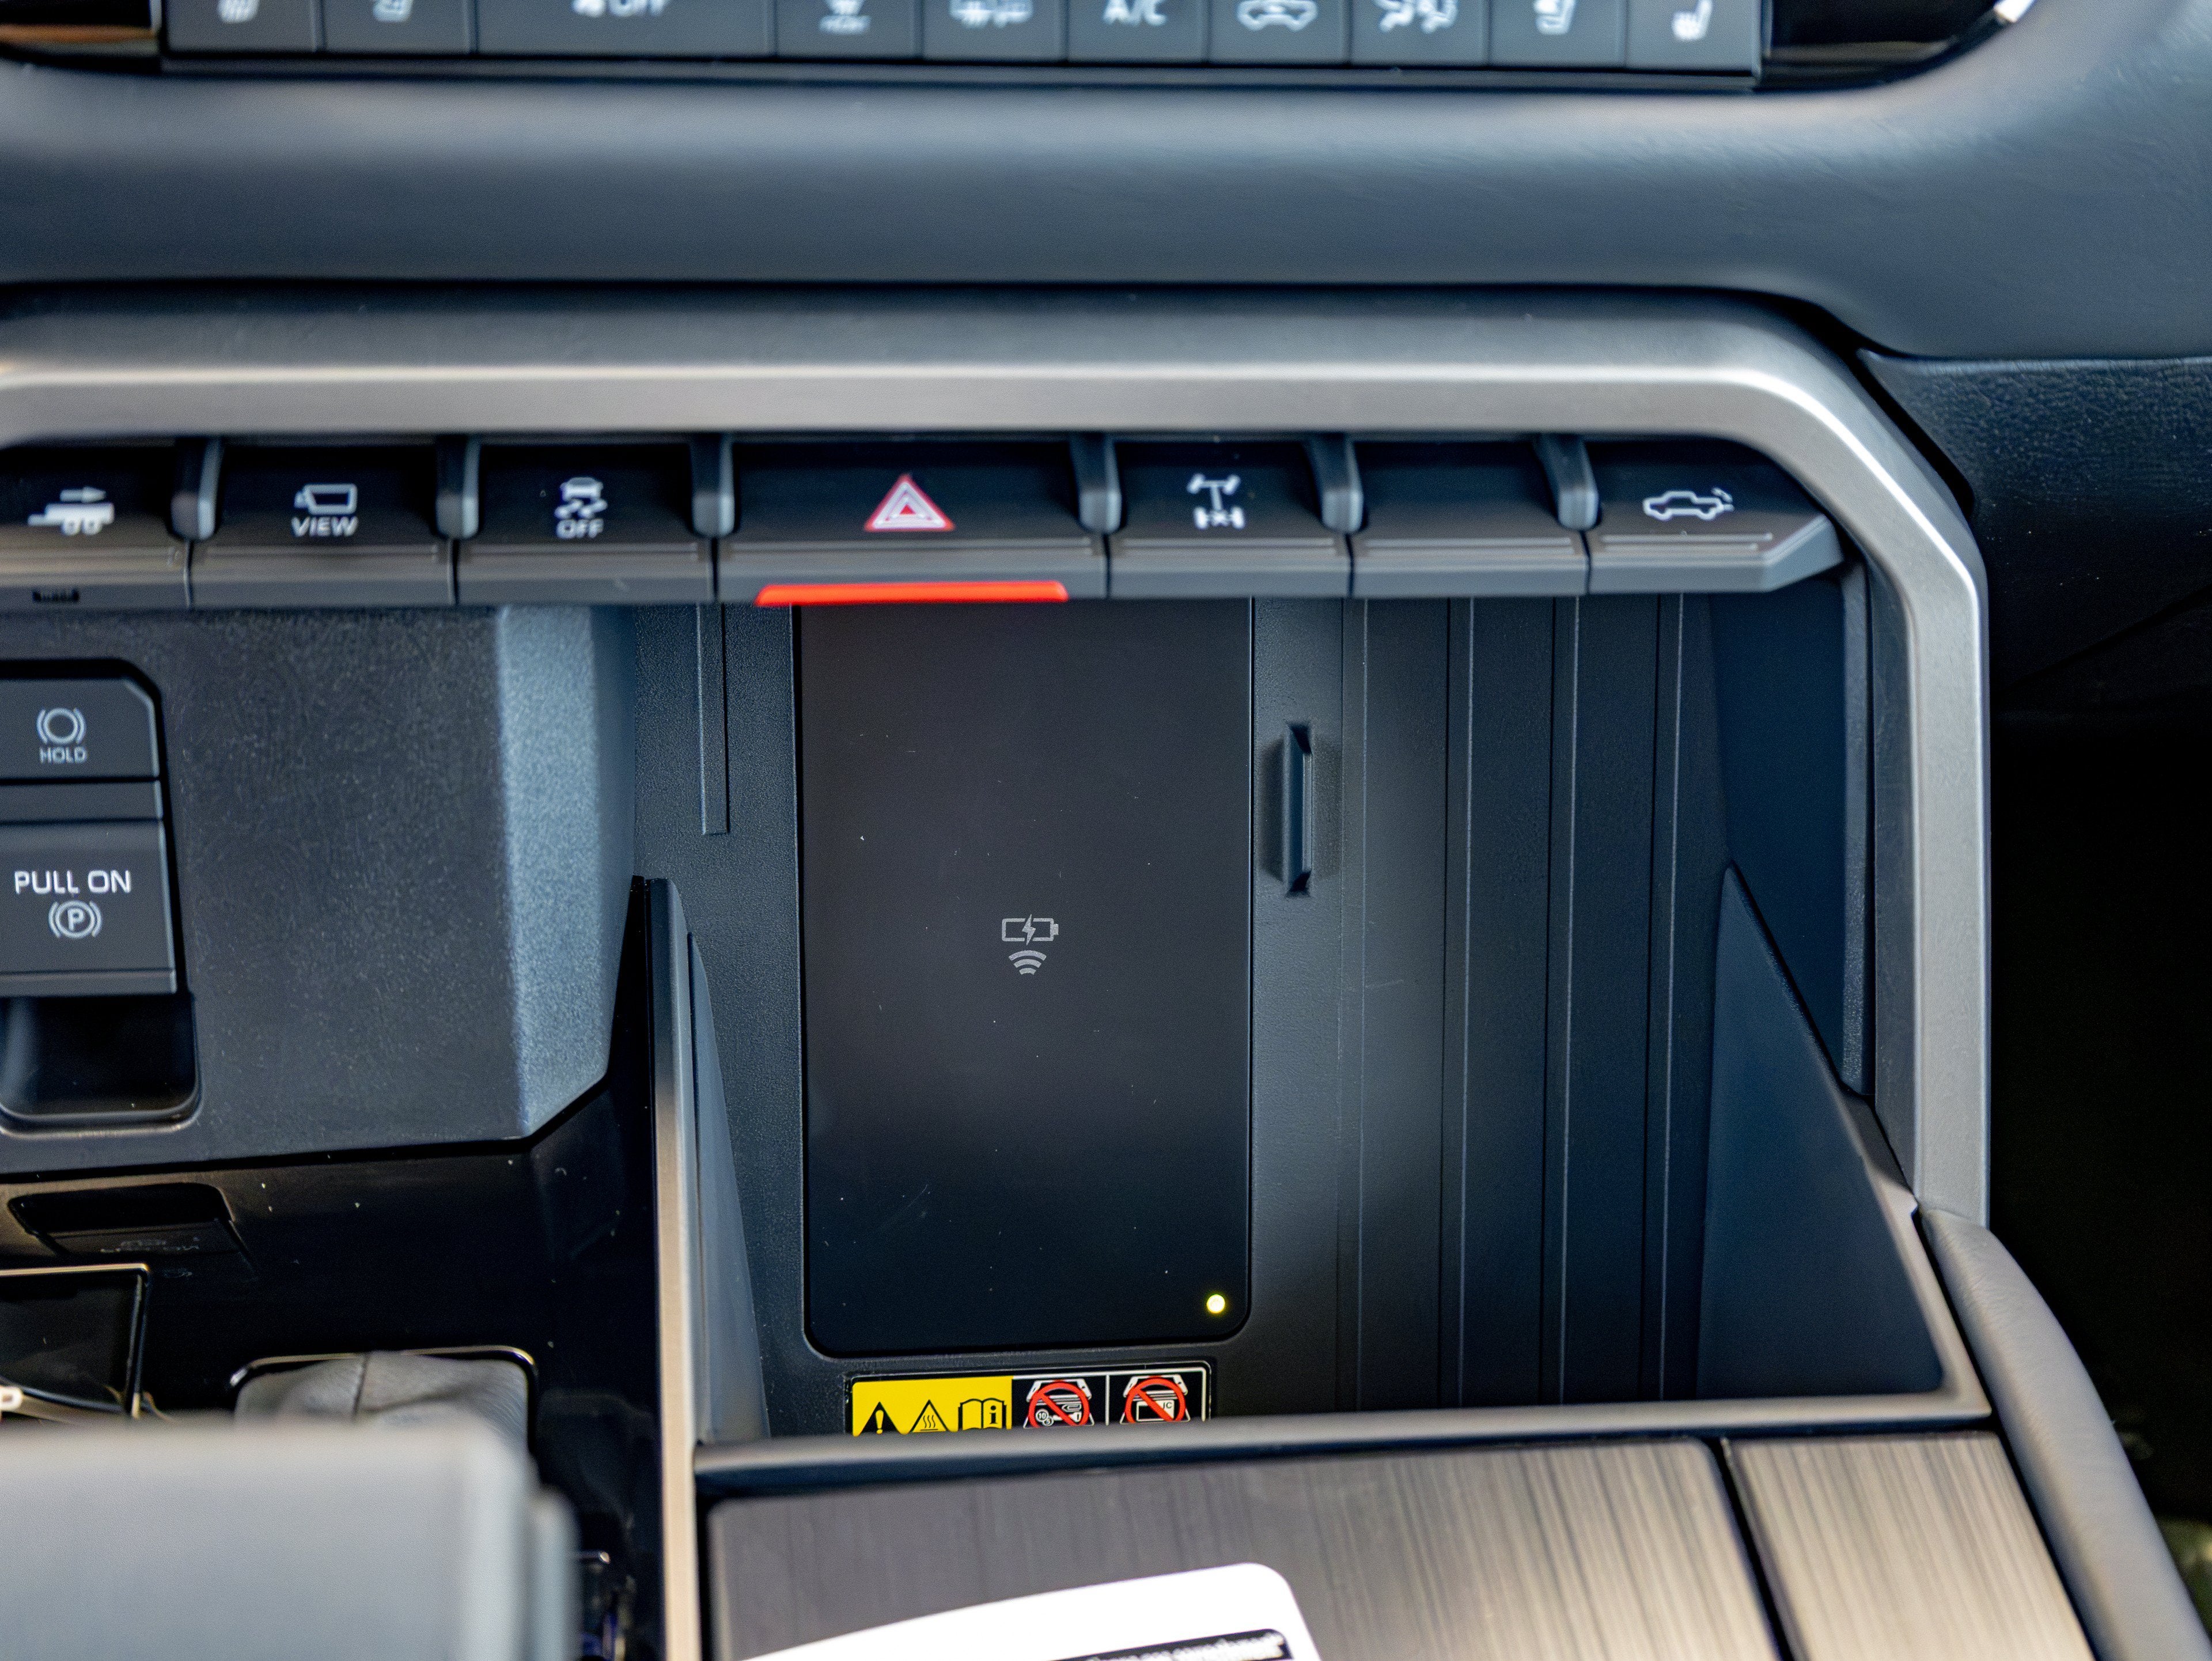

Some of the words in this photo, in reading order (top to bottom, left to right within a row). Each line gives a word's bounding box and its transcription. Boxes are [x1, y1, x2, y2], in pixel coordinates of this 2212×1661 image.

[291, 516, 359, 536] VIEW
[556, 519, 604, 539] OFF
[39, 746, 87, 764] HOLD
[14, 871, 80, 894] PULL
[88, 870, 131, 893] ON
